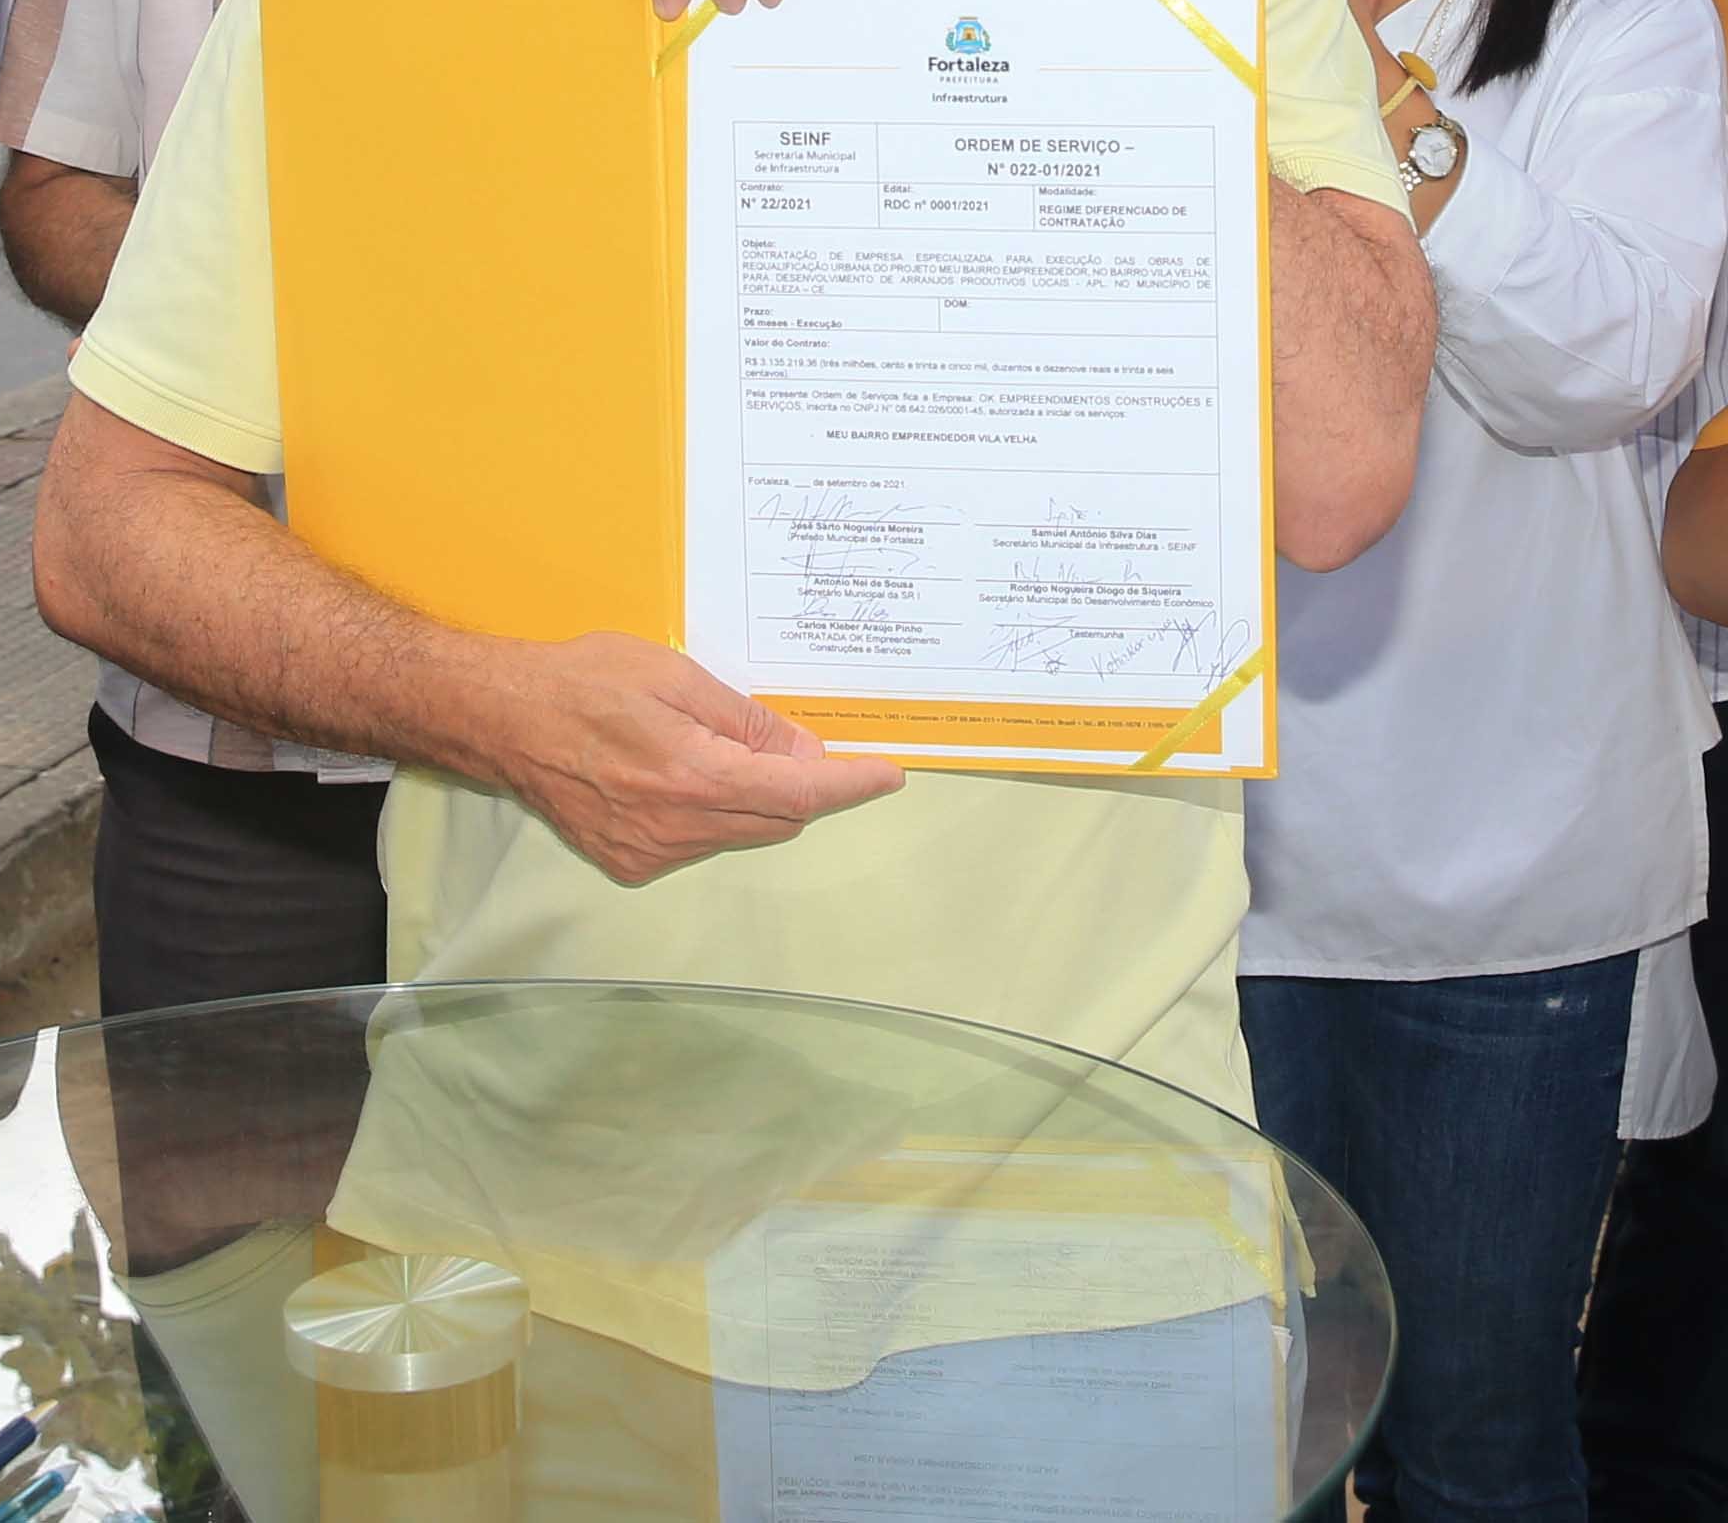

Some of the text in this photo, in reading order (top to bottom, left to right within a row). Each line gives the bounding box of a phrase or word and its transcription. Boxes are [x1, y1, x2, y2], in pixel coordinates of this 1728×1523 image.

[928, 56, 1010, 72] Fortaleza
[939, 76, 999, 84] PREFEITURA
[932, 93, 1008, 104] Infraestrutura
[779, 132, 831, 146] SEINF
[954, 138, 1120, 156] ORDEM DE SERVIÇO
[754, 150, 856, 164] Secretaria Municipal
[754, 164, 839, 174] de Infraestrutura
[1010, 162, 1101, 177] 022-01/2021
[740, 183, 784, 192] Contrato:
[883, 184, 912, 193] Edital:
[1039, 187, 1097, 197] Modalidade:
[761, 198, 812, 210] 22/2021
[884, 199, 911, 210] RDC
[930, 200, 989, 212] 0001/2021
[1039, 205, 1187, 216] REGIME DIFERENCIADO DE
[1039, 216, 1125, 229] CONTRATAÇÃO
[742, 239, 776, 250] Objeto:
[744, 308, 774, 317] Prazo:
[797, 319, 842, 330] Execução
[744, 339, 831, 349] Valor do Contrato:
[826, 430, 1037, 444] MEU BAIRRO EMPREENDEDOR VILA VELHA
[1031, 528, 1067, 538] Samuel
[1110, 530, 1135, 539] Silva
[1138, 531, 1157, 539] Dias
[1010, 583, 1048, 594] Rodrigo
[1051, 584, 1094, 596] Nogueira
[1141, 586, 1181, 597] Siqueira
